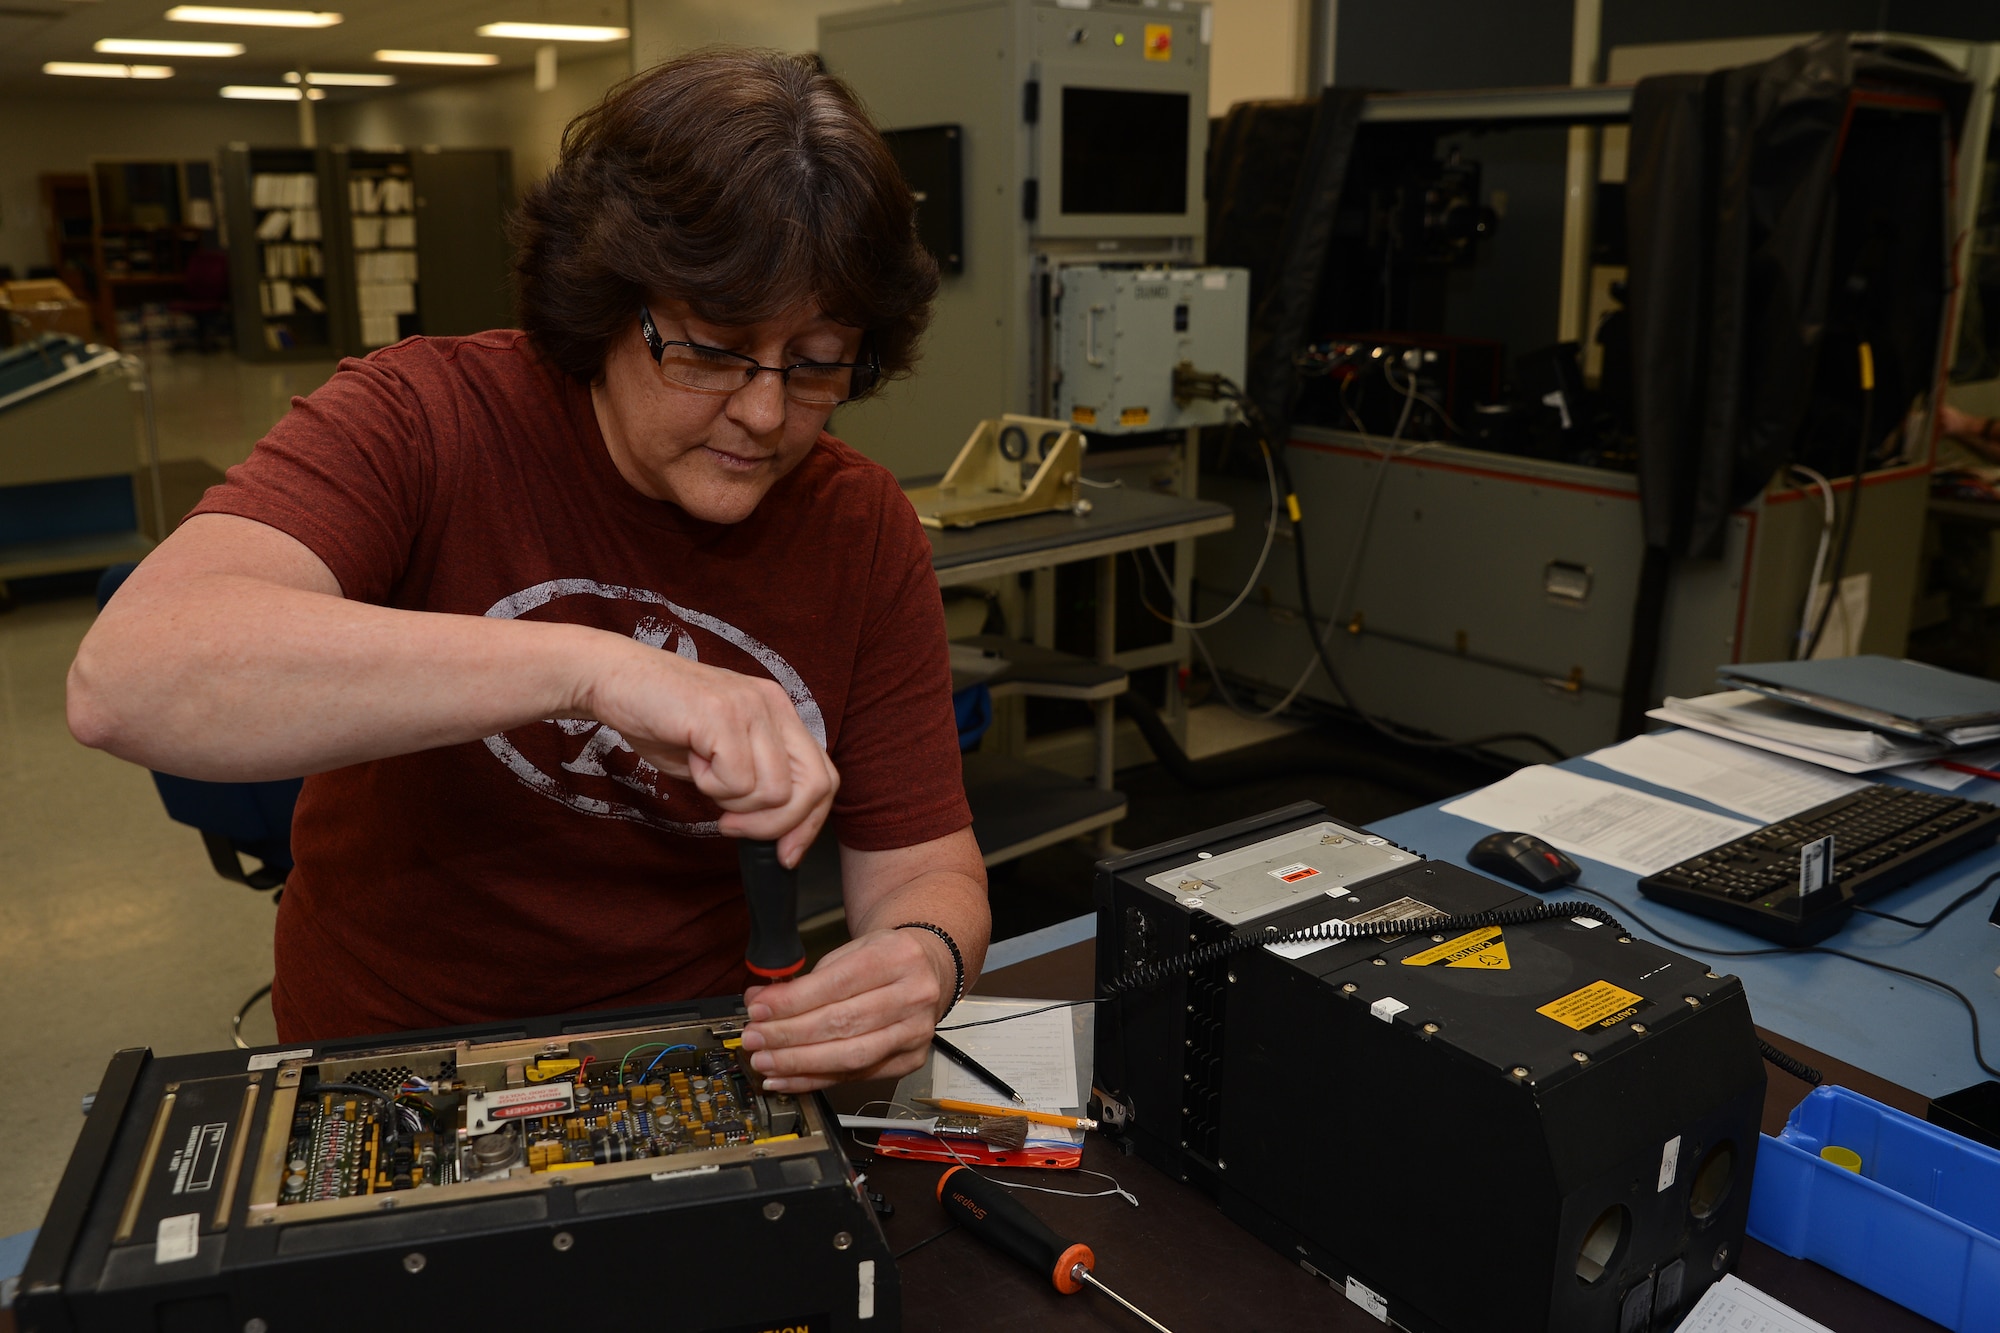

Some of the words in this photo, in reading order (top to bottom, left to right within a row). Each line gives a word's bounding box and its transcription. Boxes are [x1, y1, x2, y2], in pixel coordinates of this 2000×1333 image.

[1446, 941, 1493, 962] CAUTION
[1600, 1008, 1638, 1028] CAUTION
[497, 1094, 537, 1105] VOLTAGE
[505, 1102, 557, 1116] DANGER
